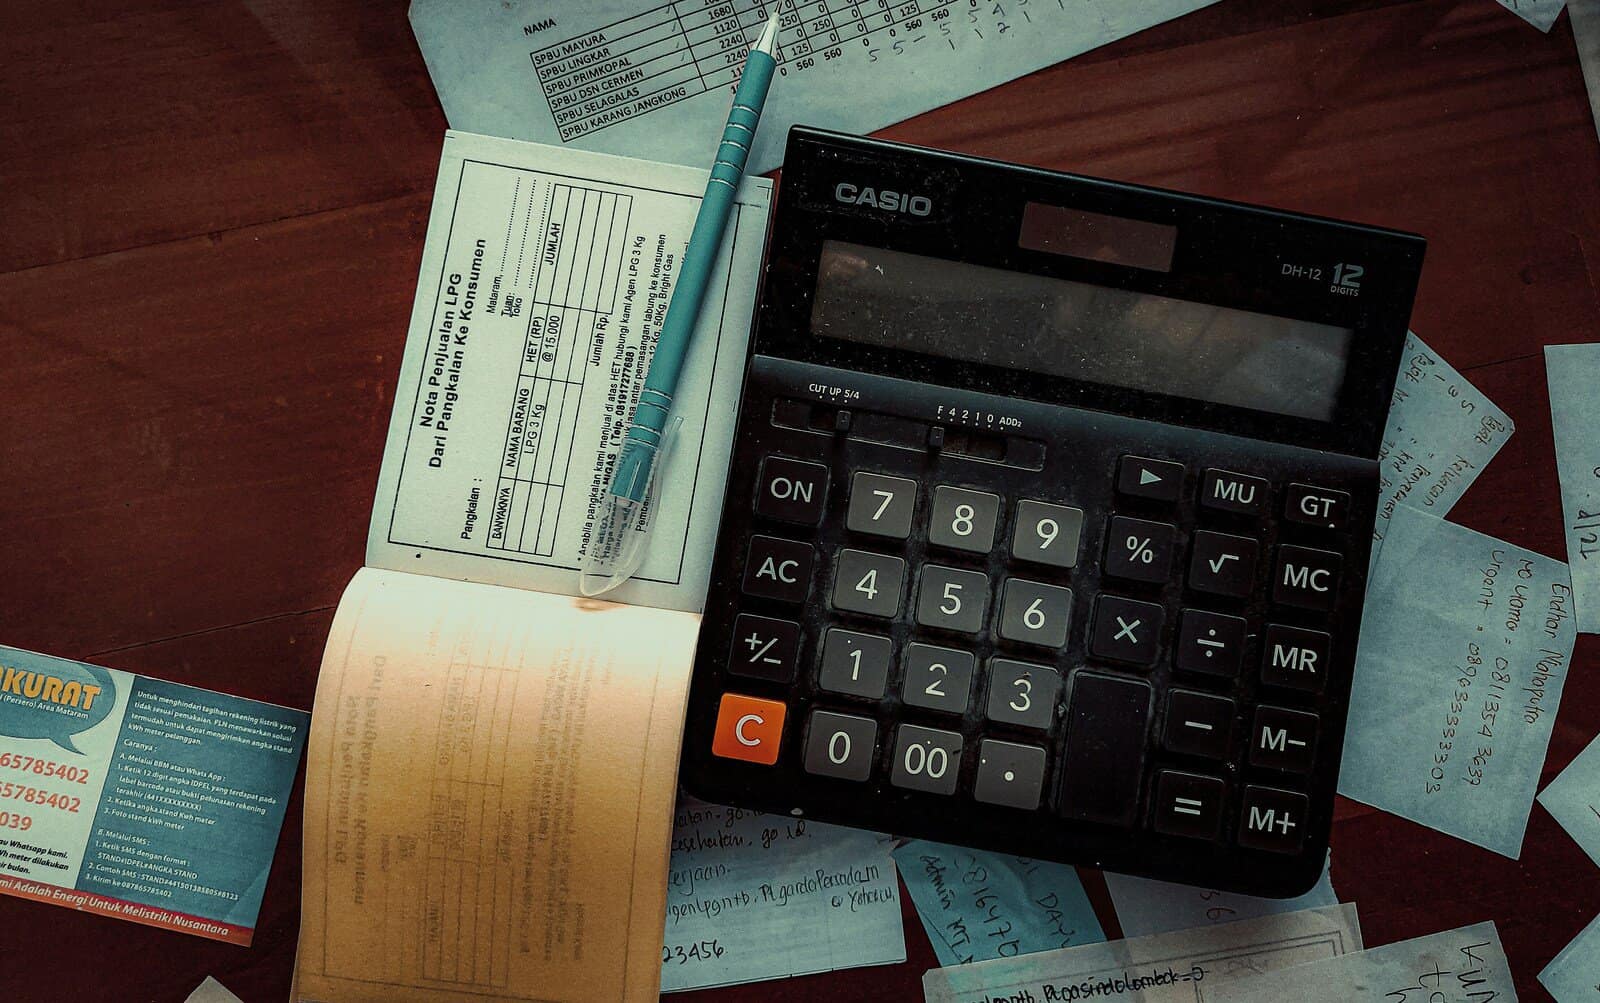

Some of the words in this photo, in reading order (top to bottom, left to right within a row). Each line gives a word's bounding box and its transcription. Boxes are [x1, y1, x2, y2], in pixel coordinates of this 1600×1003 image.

[707, 5, 731, 20] 1680
[778, 13, 797, 27] 250
[812, 18, 830, 31] 250
[899, 4, 916, 17] 125
[523, 18, 557, 36] NAMA
[713, 19, 737, 34] 1120
[719, 33, 742, 49] 2240
[796, 57, 814, 70] 560
[823, 47, 841, 60] 560
[904, 18, 922, 31] 560
[931, 8, 949, 21] 560
[534, 48, 560, 64] SPBU
[561, 33, 606, 55] MAYURA
[540, 63, 566, 79] SPBU
[567, 47, 610, 69] LINGKAR
[791, 42, 808, 56] 125
[545, 77, 571, 94] SPBU
[572, 57, 632, 84] PRIMKOPAL
[551, 92, 577, 108] SPBU
[578, 84, 599, 98] DSN
[601, 68, 643, 90] CERMEN
[556, 106, 582, 123] SPBU
[583, 86, 639, 113] SELAGALAS
[562, 121, 588, 138] SPBU
[589, 106, 631, 128] KARANG
[633, 86, 686, 113] JANGKONG
[835, 183, 932, 216] CASIO
[544, 222, 560, 265] JUMLAH
[633, 235, 645, 247] Kg
[650, 234, 666, 278] konsumen
[628, 257, 639, 276] LPG
[662, 253, 673, 271] Gas
[1281, 263, 1322, 281] DH-12
[1333, 263, 1364, 288] 12
[444, 273, 461, 305] LPG
[458, 239, 485, 320] Konsumen
[485, 274, 503, 313] Mataram,
[624, 278, 636, 302] Agen
[648, 279, 658, 290] ke
[657, 273, 670, 299] Bright
[1330, 285, 1360, 297] DIGITS
[510, 297, 522, 317] Toko
[595, 314, 609, 330] Rp.
[619, 302, 632, 323] kami
[643, 292, 657, 321] tabung
[453, 325, 468, 345] Ke
[530, 316, 544, 338] (RP)
[544, 315, 560, 348] 15.000
[613, 325, 629, 359] hubungi
[427, 310, 455, 386] Penjualan
[525, 340, 538, 362] HET
[541, 351, 553, 362] @
[589, 332, 605, 366] Jumlah
[634, 324, 650, 379] pemasangan
[610, 360, 621, 380] HET
[615, 351, 634, 415] 081917277688
[436, 350, 464, 431] Pangkalan
[607, 383, 617, 401] atas
[630, 380, 640, 404] antar
[809, 383, 827, 395] CUT
[829, 387, 842, 396] UP
[843, 389, 860, 400] 5/4
[419, 391, 438, 426] Nota
[511, 388, 529, 433] BARANG
[604, 403, 613, 412] di
[949, 407, 957, 417] 4
[962, 410, 969, 419] 2
[987, 414, 994, 423] 0
[523, 430, 537, 453] LPG
[530, 404, 547, 420] Kg
[599, 413, 612, 448] menjual
[610, 418, 624, 439] Telp.
[428, 435, 446, 467] Dari
[505, 435, 520, 467] NAMA
[593, 450, 605, 471] kami
[586, 473, 601, 519] pangkalan
[770, 477, 814, 504] ON
[872, 490, 894, 521] 7
[1213, 478, 1256, 505] MU
[460, 487, 480, 539] Pangkalan
[491, 487, 510, 539] BANYAKNYA
[951, 504, 976, 536] 8
[1300, 494, 1336, 519] GT
[1036, 518, 1060, 550] 9
[1126, 534, 1154, 565] %
[756, 556, 800, 584] AC
[855, 569, 879, 601] 4
[1283, 563, 1331, 593] MC
[939, 582, 963, 616] 5
[1022, 598, 1046, 630] 6
[849, 649, 863, 681] 1
[1272, 644, 1319, 673] MR
[0, 666, 101, 711] KURAT
[137, 690, 157, 700] Untuk
[924, 663, 948, 697] 2
[1008, 678, 1033, 713] 3
[3, 695, 36, 707] (Persero)
[37, 702, 54, 711] Area
[55, 706, 88, 719] Mataram
[734, 714, 764, 747] C
[827, 731, 852, 765] 0
[904, 743, 948, 779] 00
[0, 752, 89, 784] 65785402
[0, 782, 81, 813] 5785402
[1248, 806, 1296, 835] M+
[8, 853, 31, 861] meter
[31, 856, 69, 870] dilakukan
[9, 839, 46, 855] Whatsapp
[46, 847, 67, 858] kami.
[6, 862, 30, 873] bulan.
[12, 881, 51, 896] Adalah
[52, 889, 88, 905] Energi
[88, 896, 121, 912] Untuk
[121, 904, 173, 923] Melistriki
[172, 915, 228, 935] Nusantara
